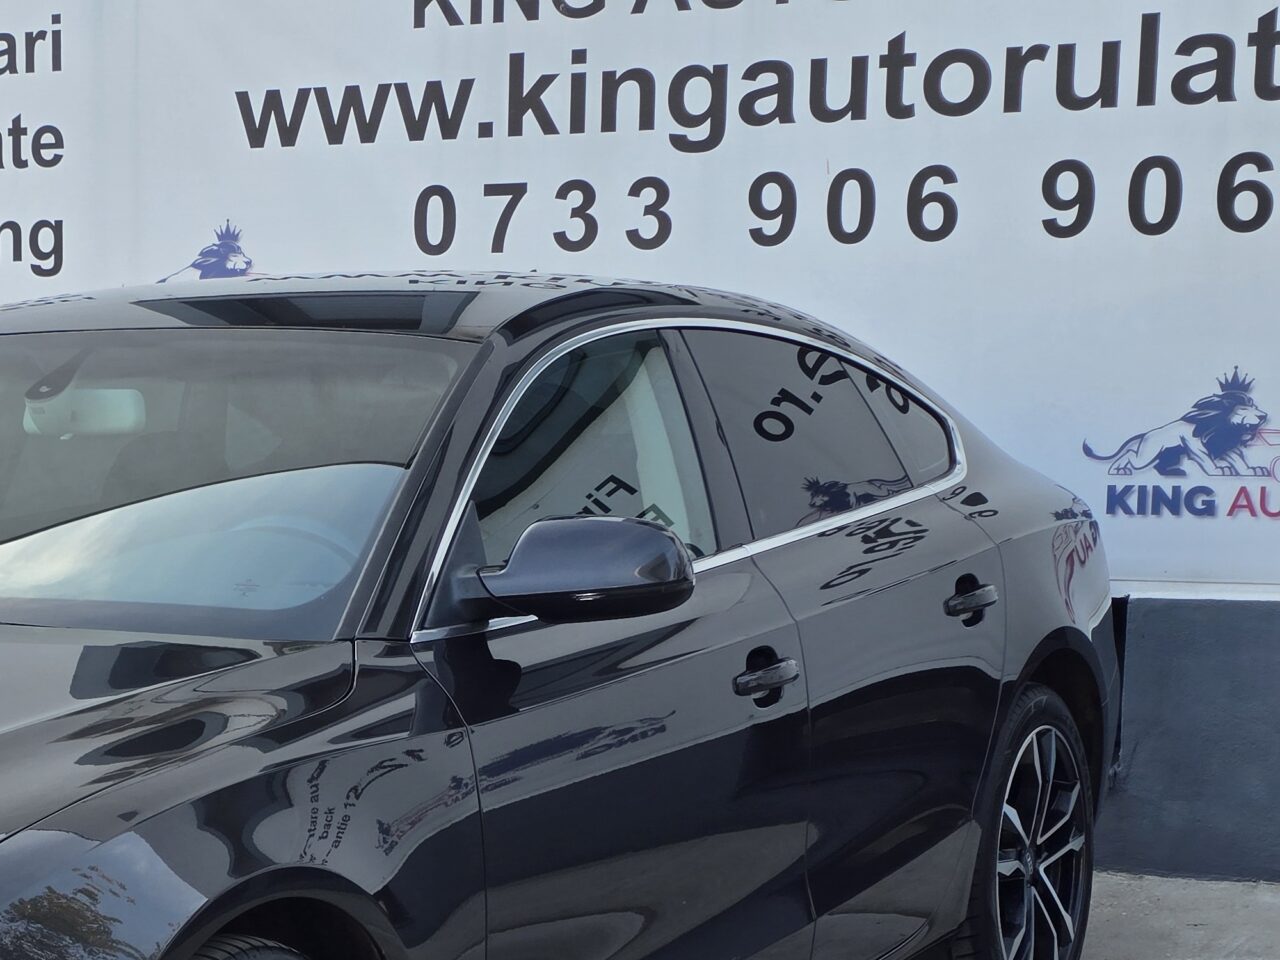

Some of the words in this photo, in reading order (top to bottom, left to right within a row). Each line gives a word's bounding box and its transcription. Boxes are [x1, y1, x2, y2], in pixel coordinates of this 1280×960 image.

[413, 176, 673, 256] 0733
[749, 166, 960, 248] 906
[1042, 151, 1275, 239] 906
[1105, 484, 1216, 517] KING
